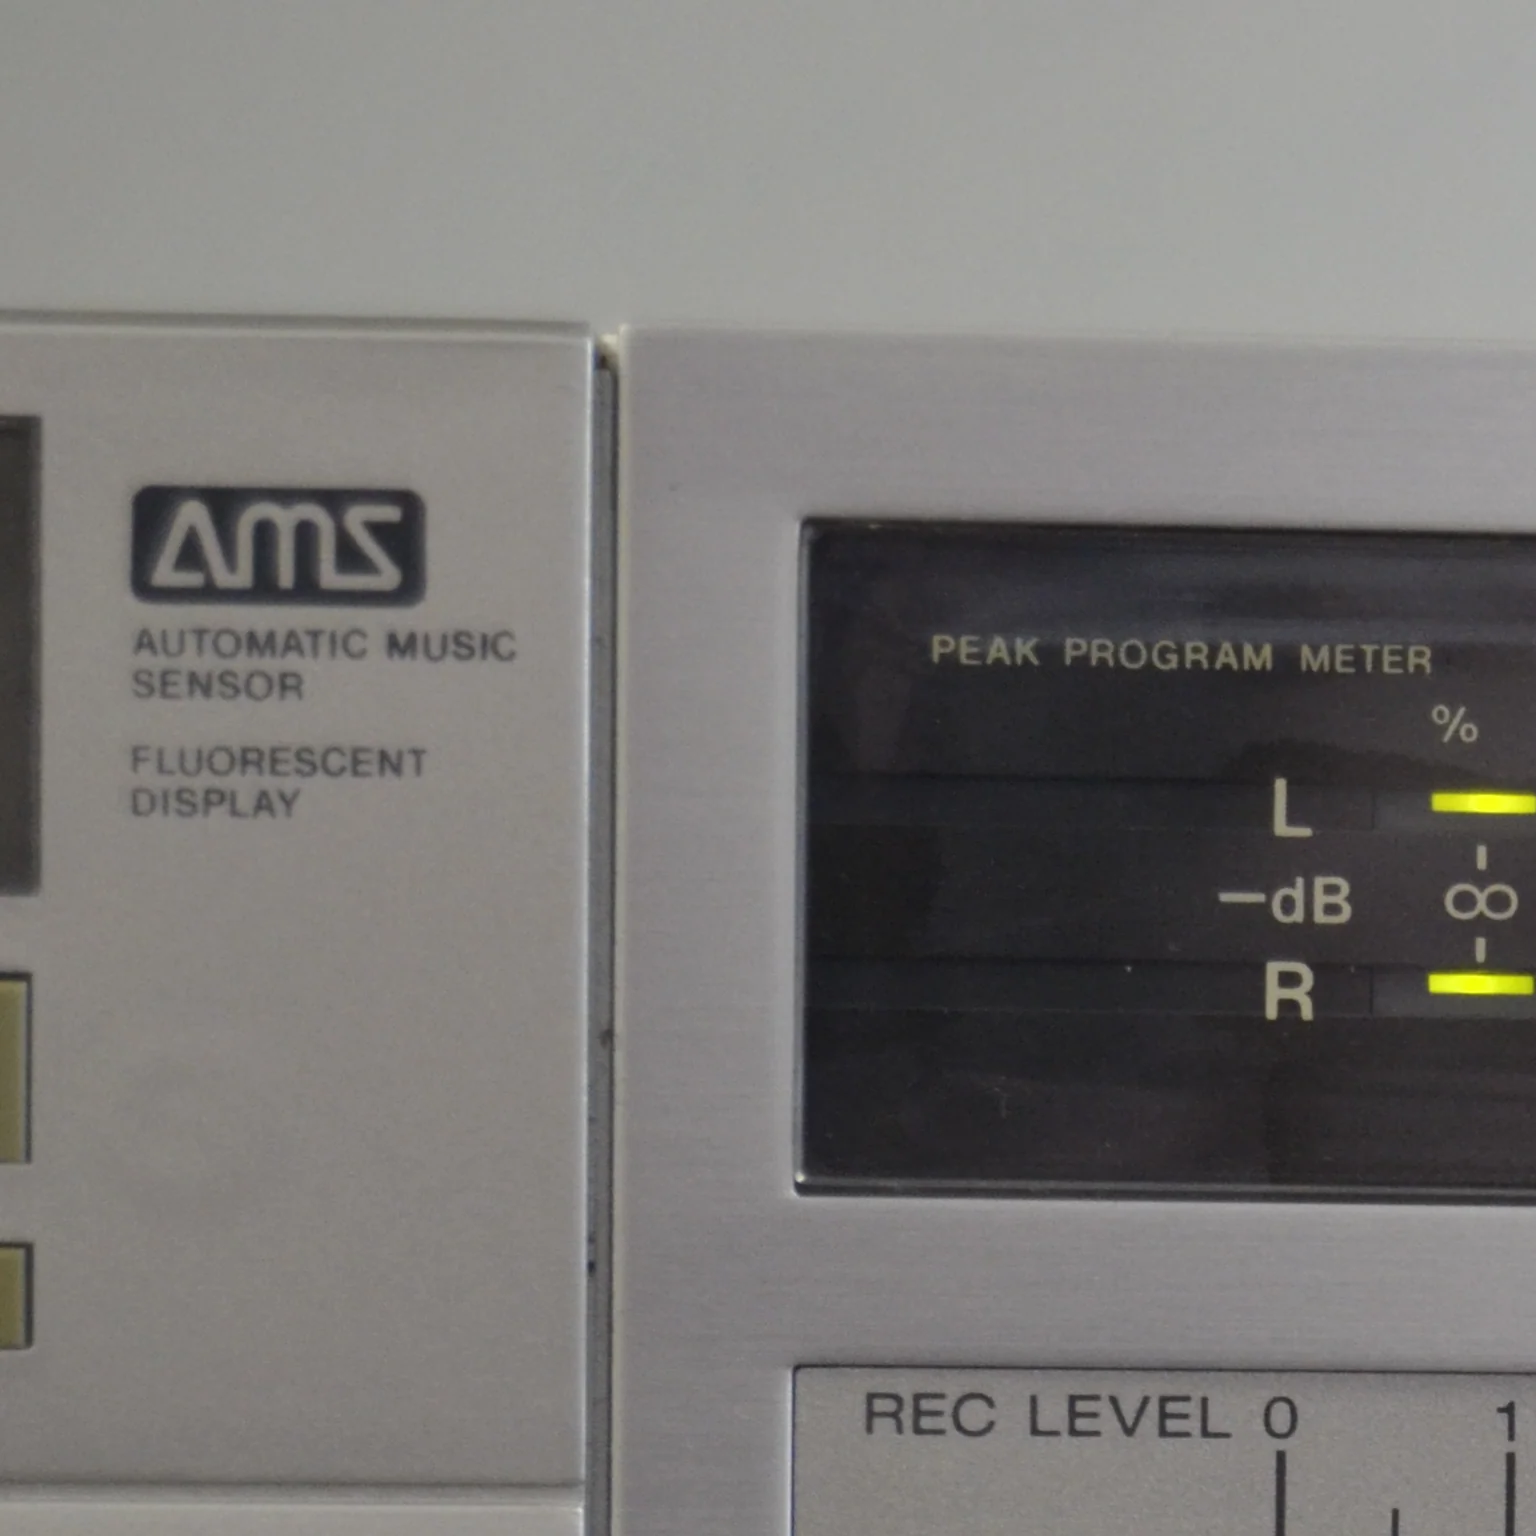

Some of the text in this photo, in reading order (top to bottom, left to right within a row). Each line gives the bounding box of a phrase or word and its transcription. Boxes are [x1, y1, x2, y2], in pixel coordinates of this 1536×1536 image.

[133, 627, 516, 662] AUTOMATIC MUSIC
[931, 633, 1432, 675] PEAK PROGRAM METER
[132, 667, 304, 702] SENSOR
[1431, 704, 1479, 743] %
[130, 745, 426, 778] FLUORESCENT
[130, 786, 300, 818] DISPLAY
[1273, 777, 1314, 838] L
[1265, 960, 1314, 1021] R
[865, 1391, 996, 1438] REC
[1029, 1393, 1232, 1439] LEVEL
[1263, 1395, 1299, 1440] 0
[1496, 1400, 1516, 1442] 1
